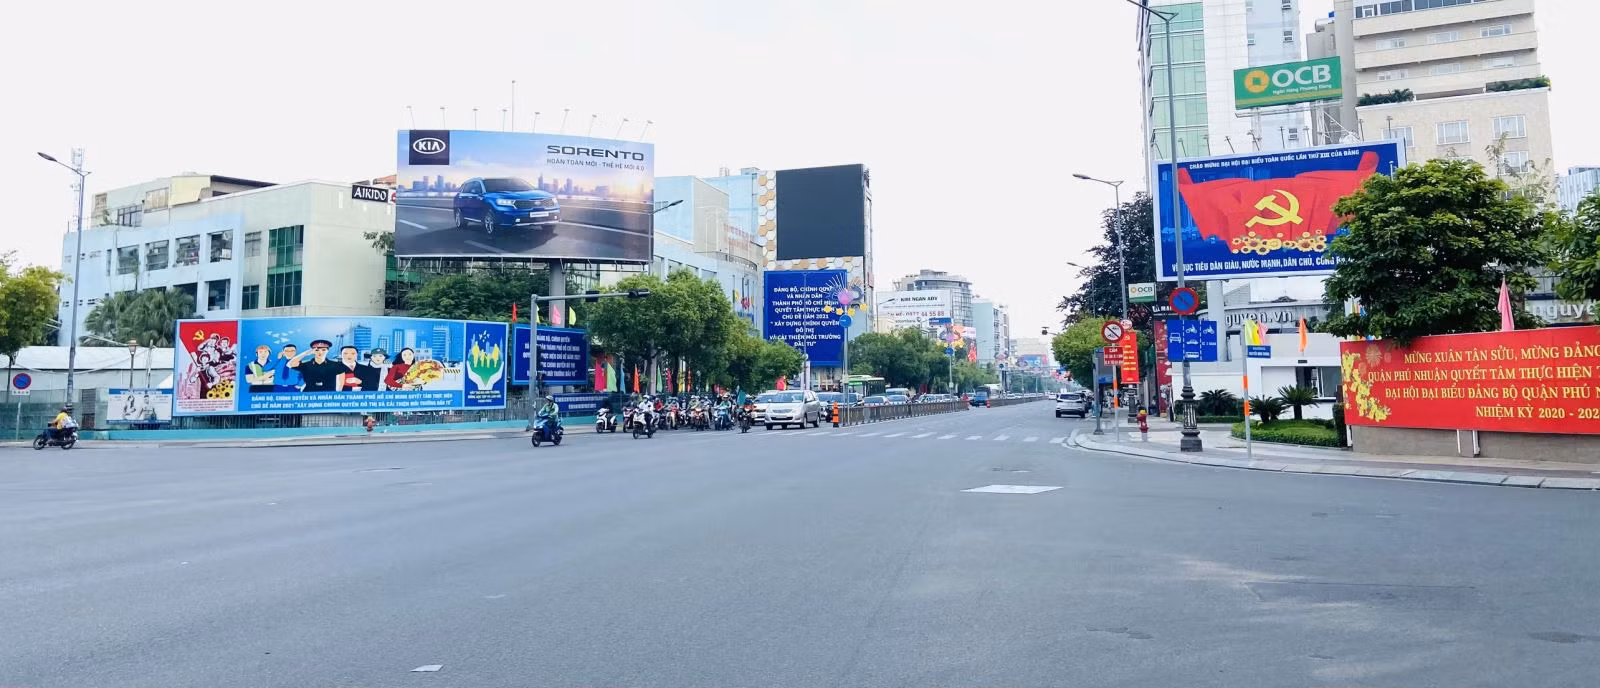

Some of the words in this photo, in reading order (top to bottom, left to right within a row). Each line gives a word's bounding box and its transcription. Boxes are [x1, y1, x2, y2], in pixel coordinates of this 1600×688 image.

[1272, 64, 1332, 88] OCB
[418, 141, 440, 150] KIA
[546, 145, 644, 161] SORENTO
[354, 187, 386, 200] AIKIDO
[1195, 261, 1208, 271] TIÊU
[1210, 260, 1223, 270] DÂN
[1224, 260, 1241, 270] GIÀU,
[1242, 258, 1259, 269] NƯỚC
[1261, 259, 1282, 270] MẠNH,
[1283, 257, 1297, 267] DÂN
[1299, 254, 1314, 266] CHỦ,
[1404, 350, 1432, 363] MỪNG
[1435, 348, 1462, 362] XUÂN
[1465, 347, 1488, 361] TÂN
[1490, 344, 1518, 361] SỬU,
[1521, 344, 1560, 359] MỪNG
[1368, 368, 1391, 383] QUẬN
[1394, 368, 1411, 381] PHÚ
[1414, 367, 1448, 382] NHUẬN
[1450, 364, 1487, 382] QUYẾT
[1490, 365, 1516, 380] TÂM
[1519, 365, 1553, 381] THỰC
[1556, 363, 1592, 380] HIỆN
[1385, 388, 1401, 400] ĐẠI
[1403, 385, 1419, 400] HỘI
[1422, 388, 1438, 400] ĐẠI
[1441, 382, 1465, 398] BIỂU
[1468, 384, 1498, 398] ĐẢNG
[1502, 384, 1518, 401] BỘ
[1522, 384, 1558, 401] QUẬN
[1562, 383, 1591, 398] PHÚ
[1476, 404, 1514, 420] NHIỆM
[1517, 404, 1534, 418] KỲ
[1539, 408, 1566, 418] 2020
